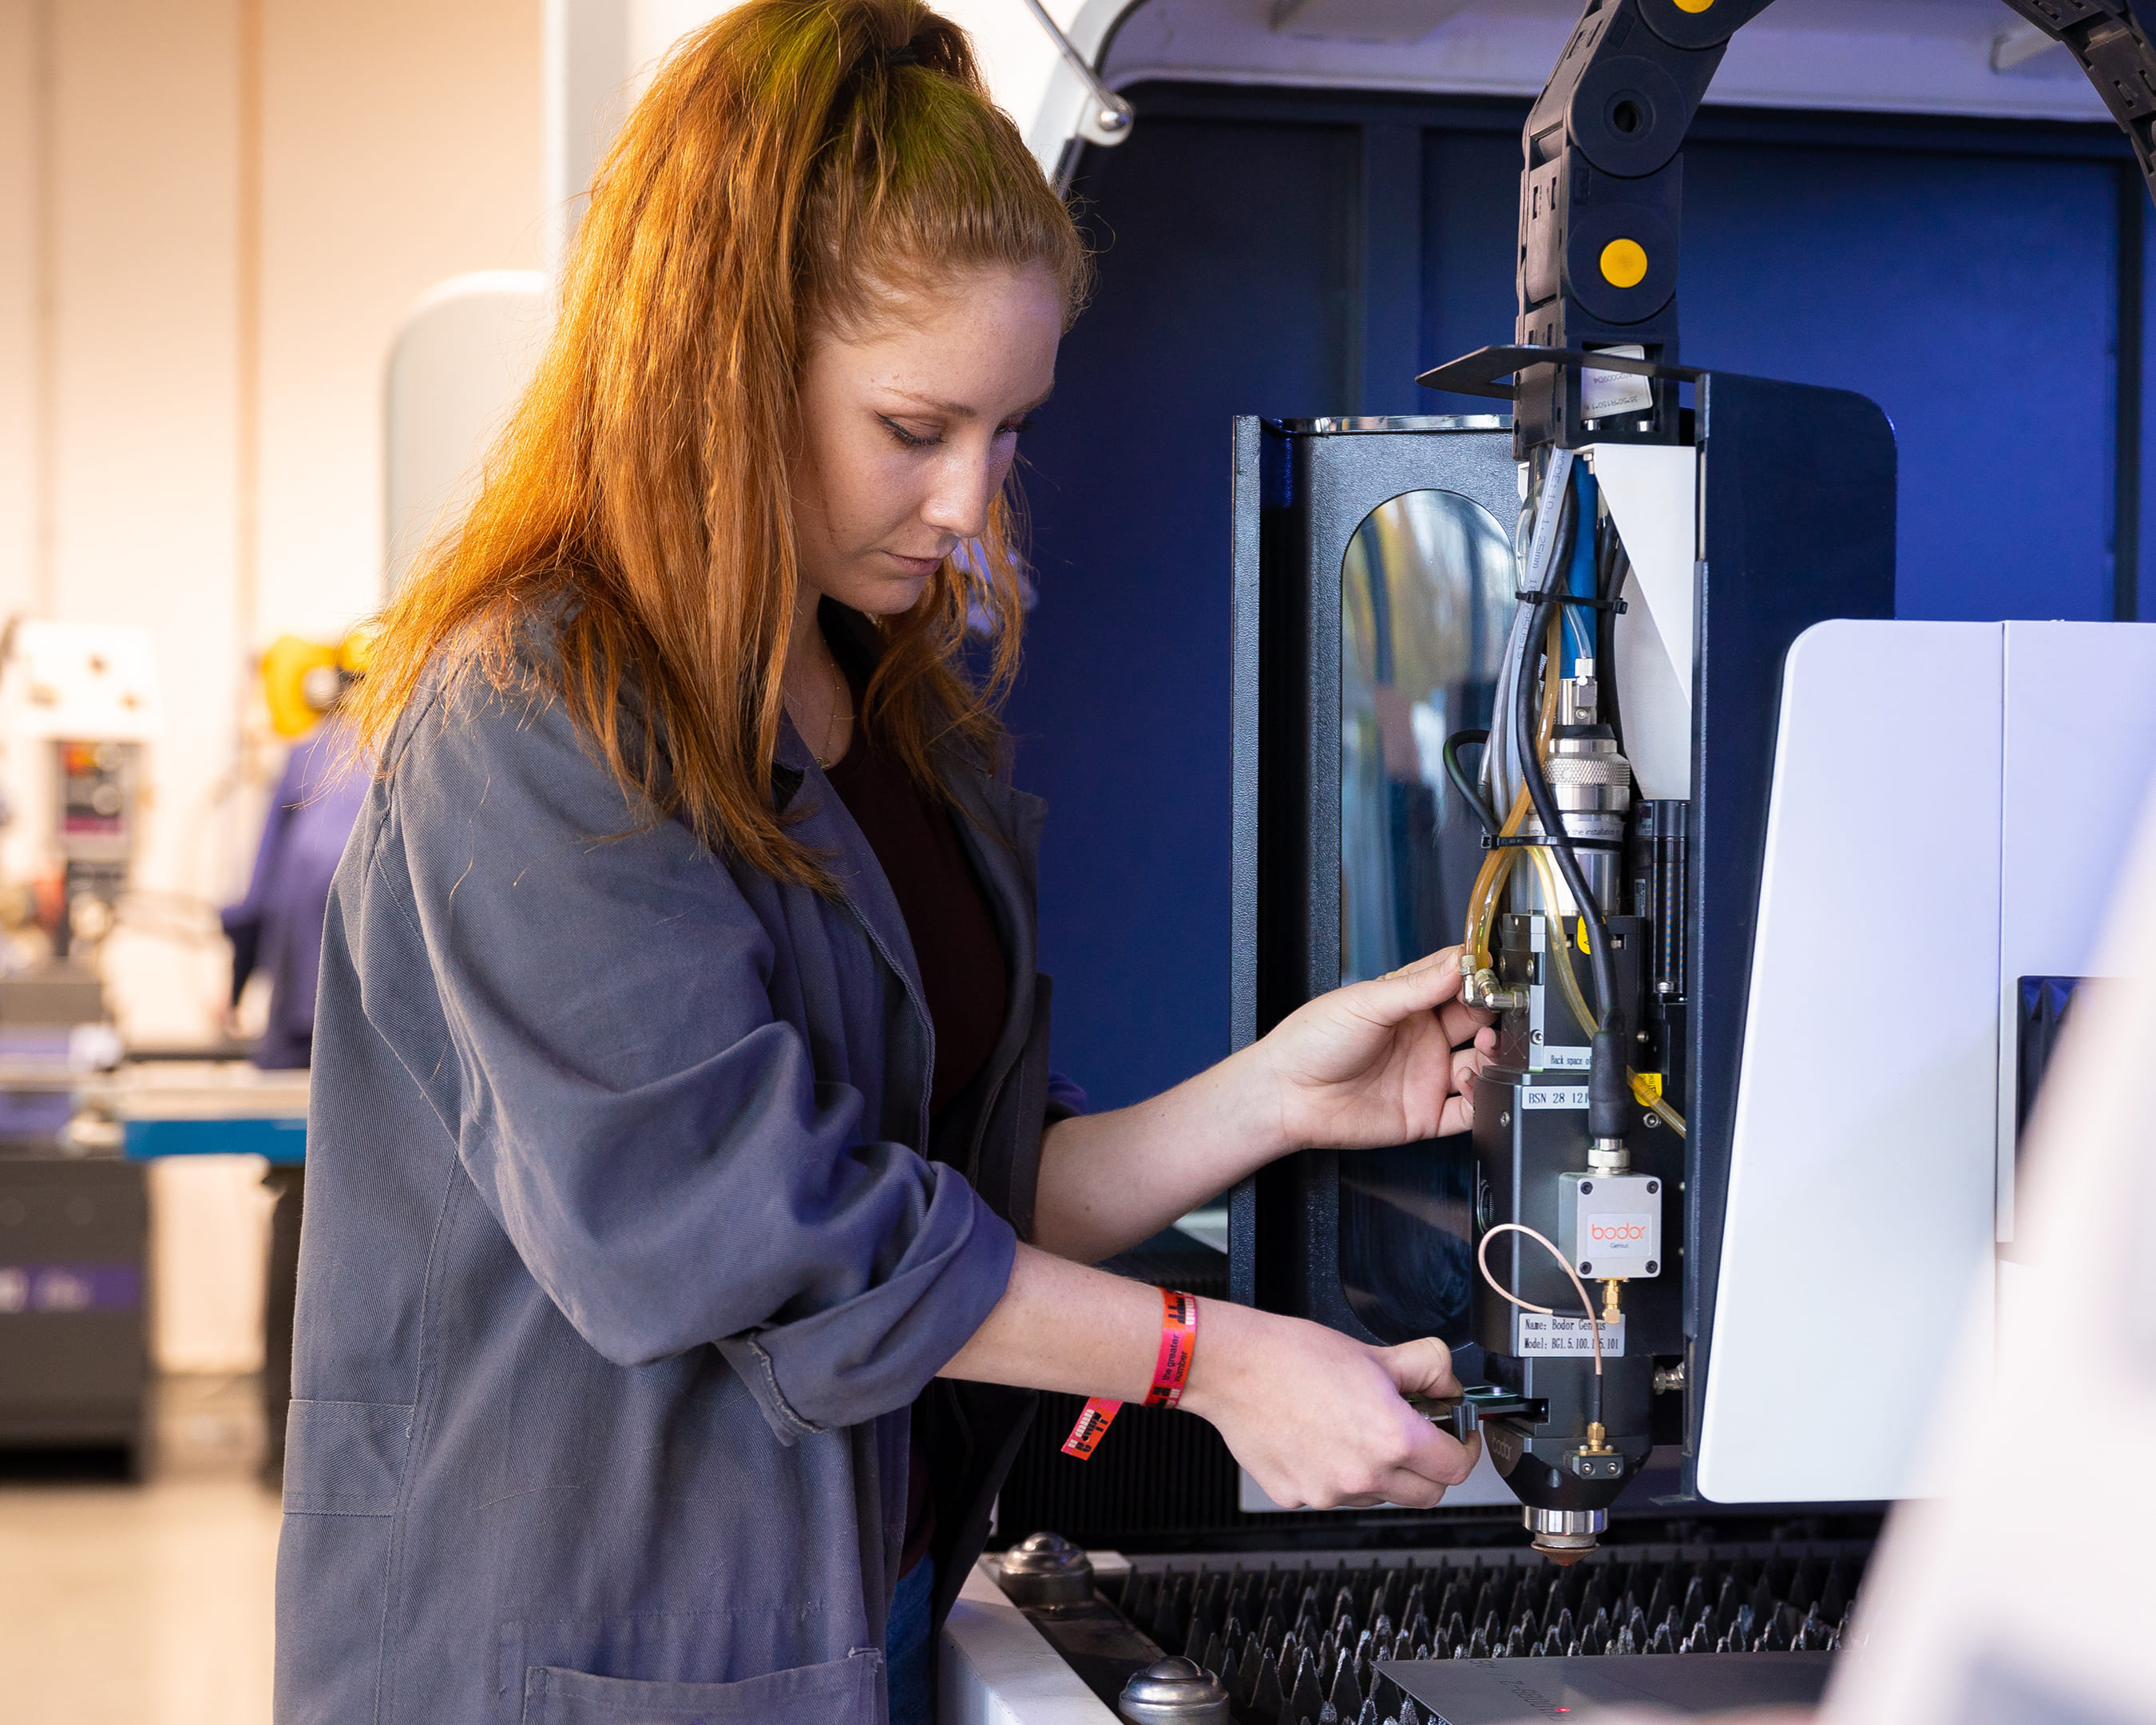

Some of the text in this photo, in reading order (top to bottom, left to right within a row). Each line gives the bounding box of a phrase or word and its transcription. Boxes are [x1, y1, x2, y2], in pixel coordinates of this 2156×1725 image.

[1551, 1054, 1563, 1065] Back
[1528, 1092, 1547, 1104] BSN
[1553, 1092, 1565, 1104] 28
[1591, 1222, 1646, 1239] bodor
[1525, 1319, 1606, 1330] Name: Bodor Genus
[1524, 1337, 1548, 1349] Model:
[1167, 1334, 1179, 1368] greater
[1174, 1350, 1188, 1382] number
